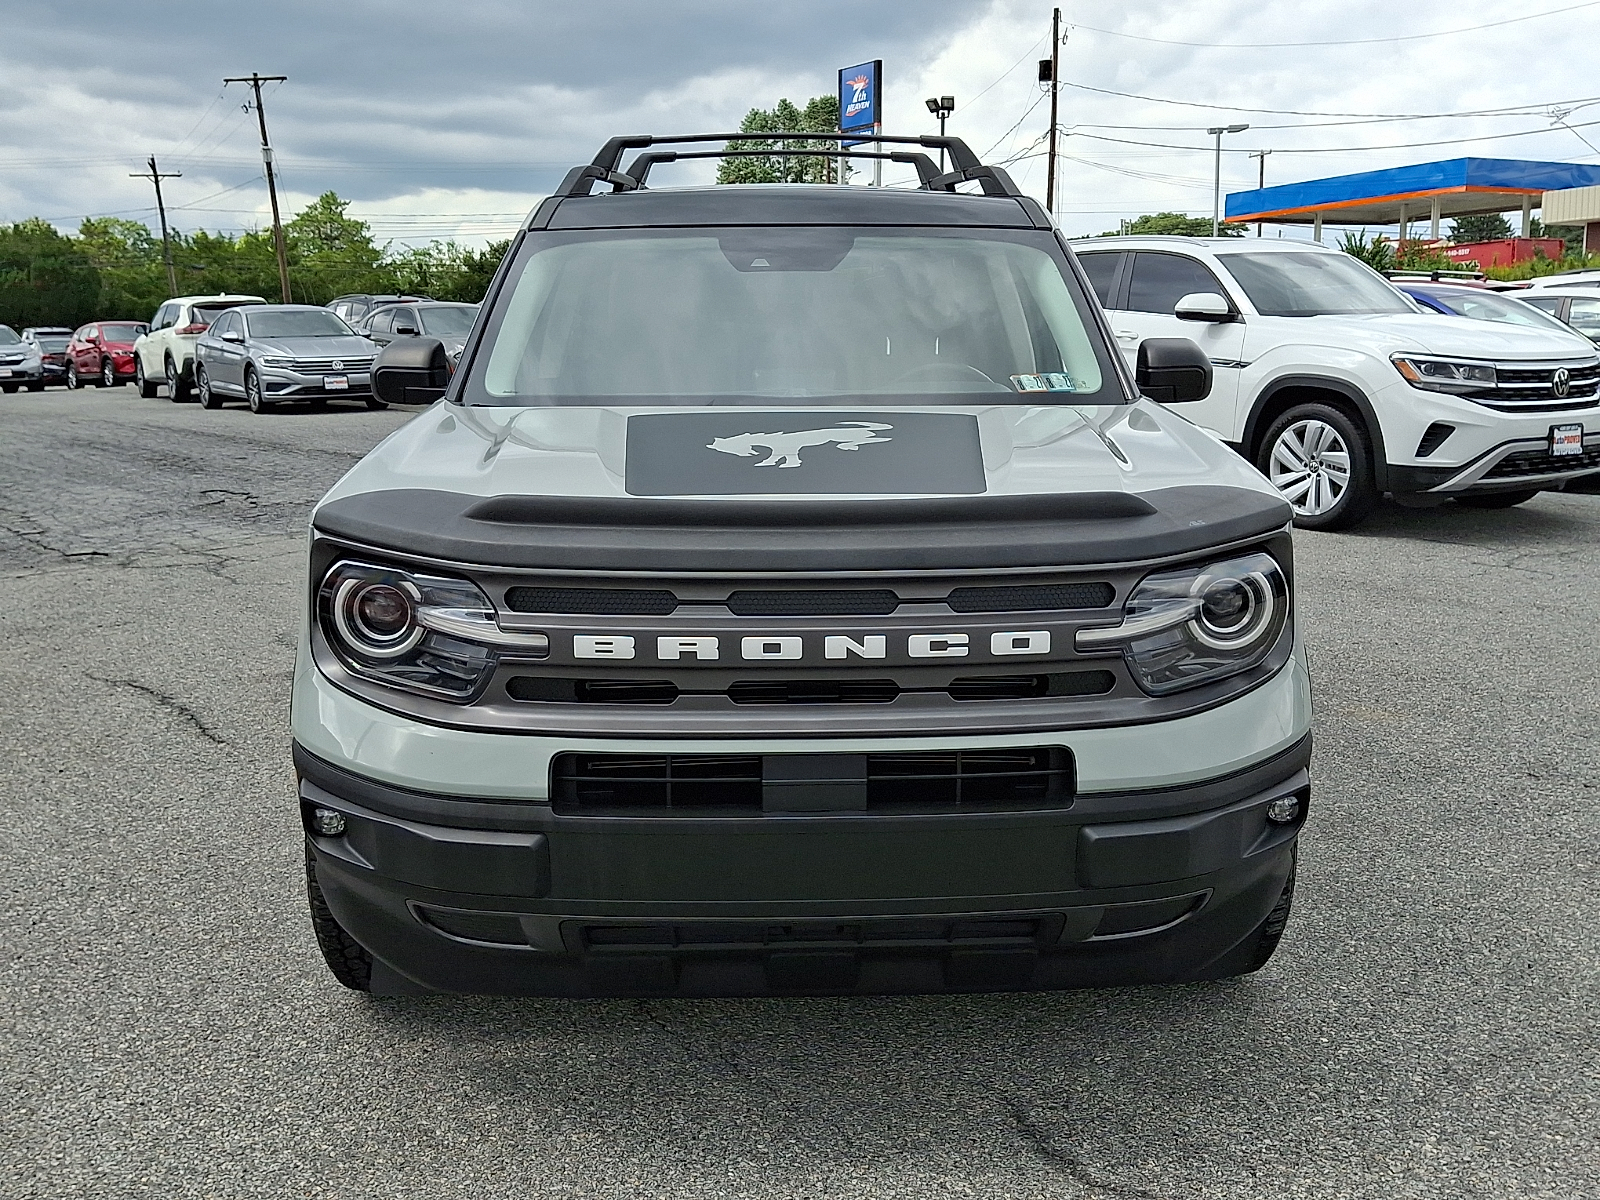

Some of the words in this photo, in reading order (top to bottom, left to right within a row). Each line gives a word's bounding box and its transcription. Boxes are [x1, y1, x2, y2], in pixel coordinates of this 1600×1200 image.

[852, 82, 867, 103] 7th
[846, 101, 871, 113] HEAVEN
[573, 630, 1051, 660] BRONCO
